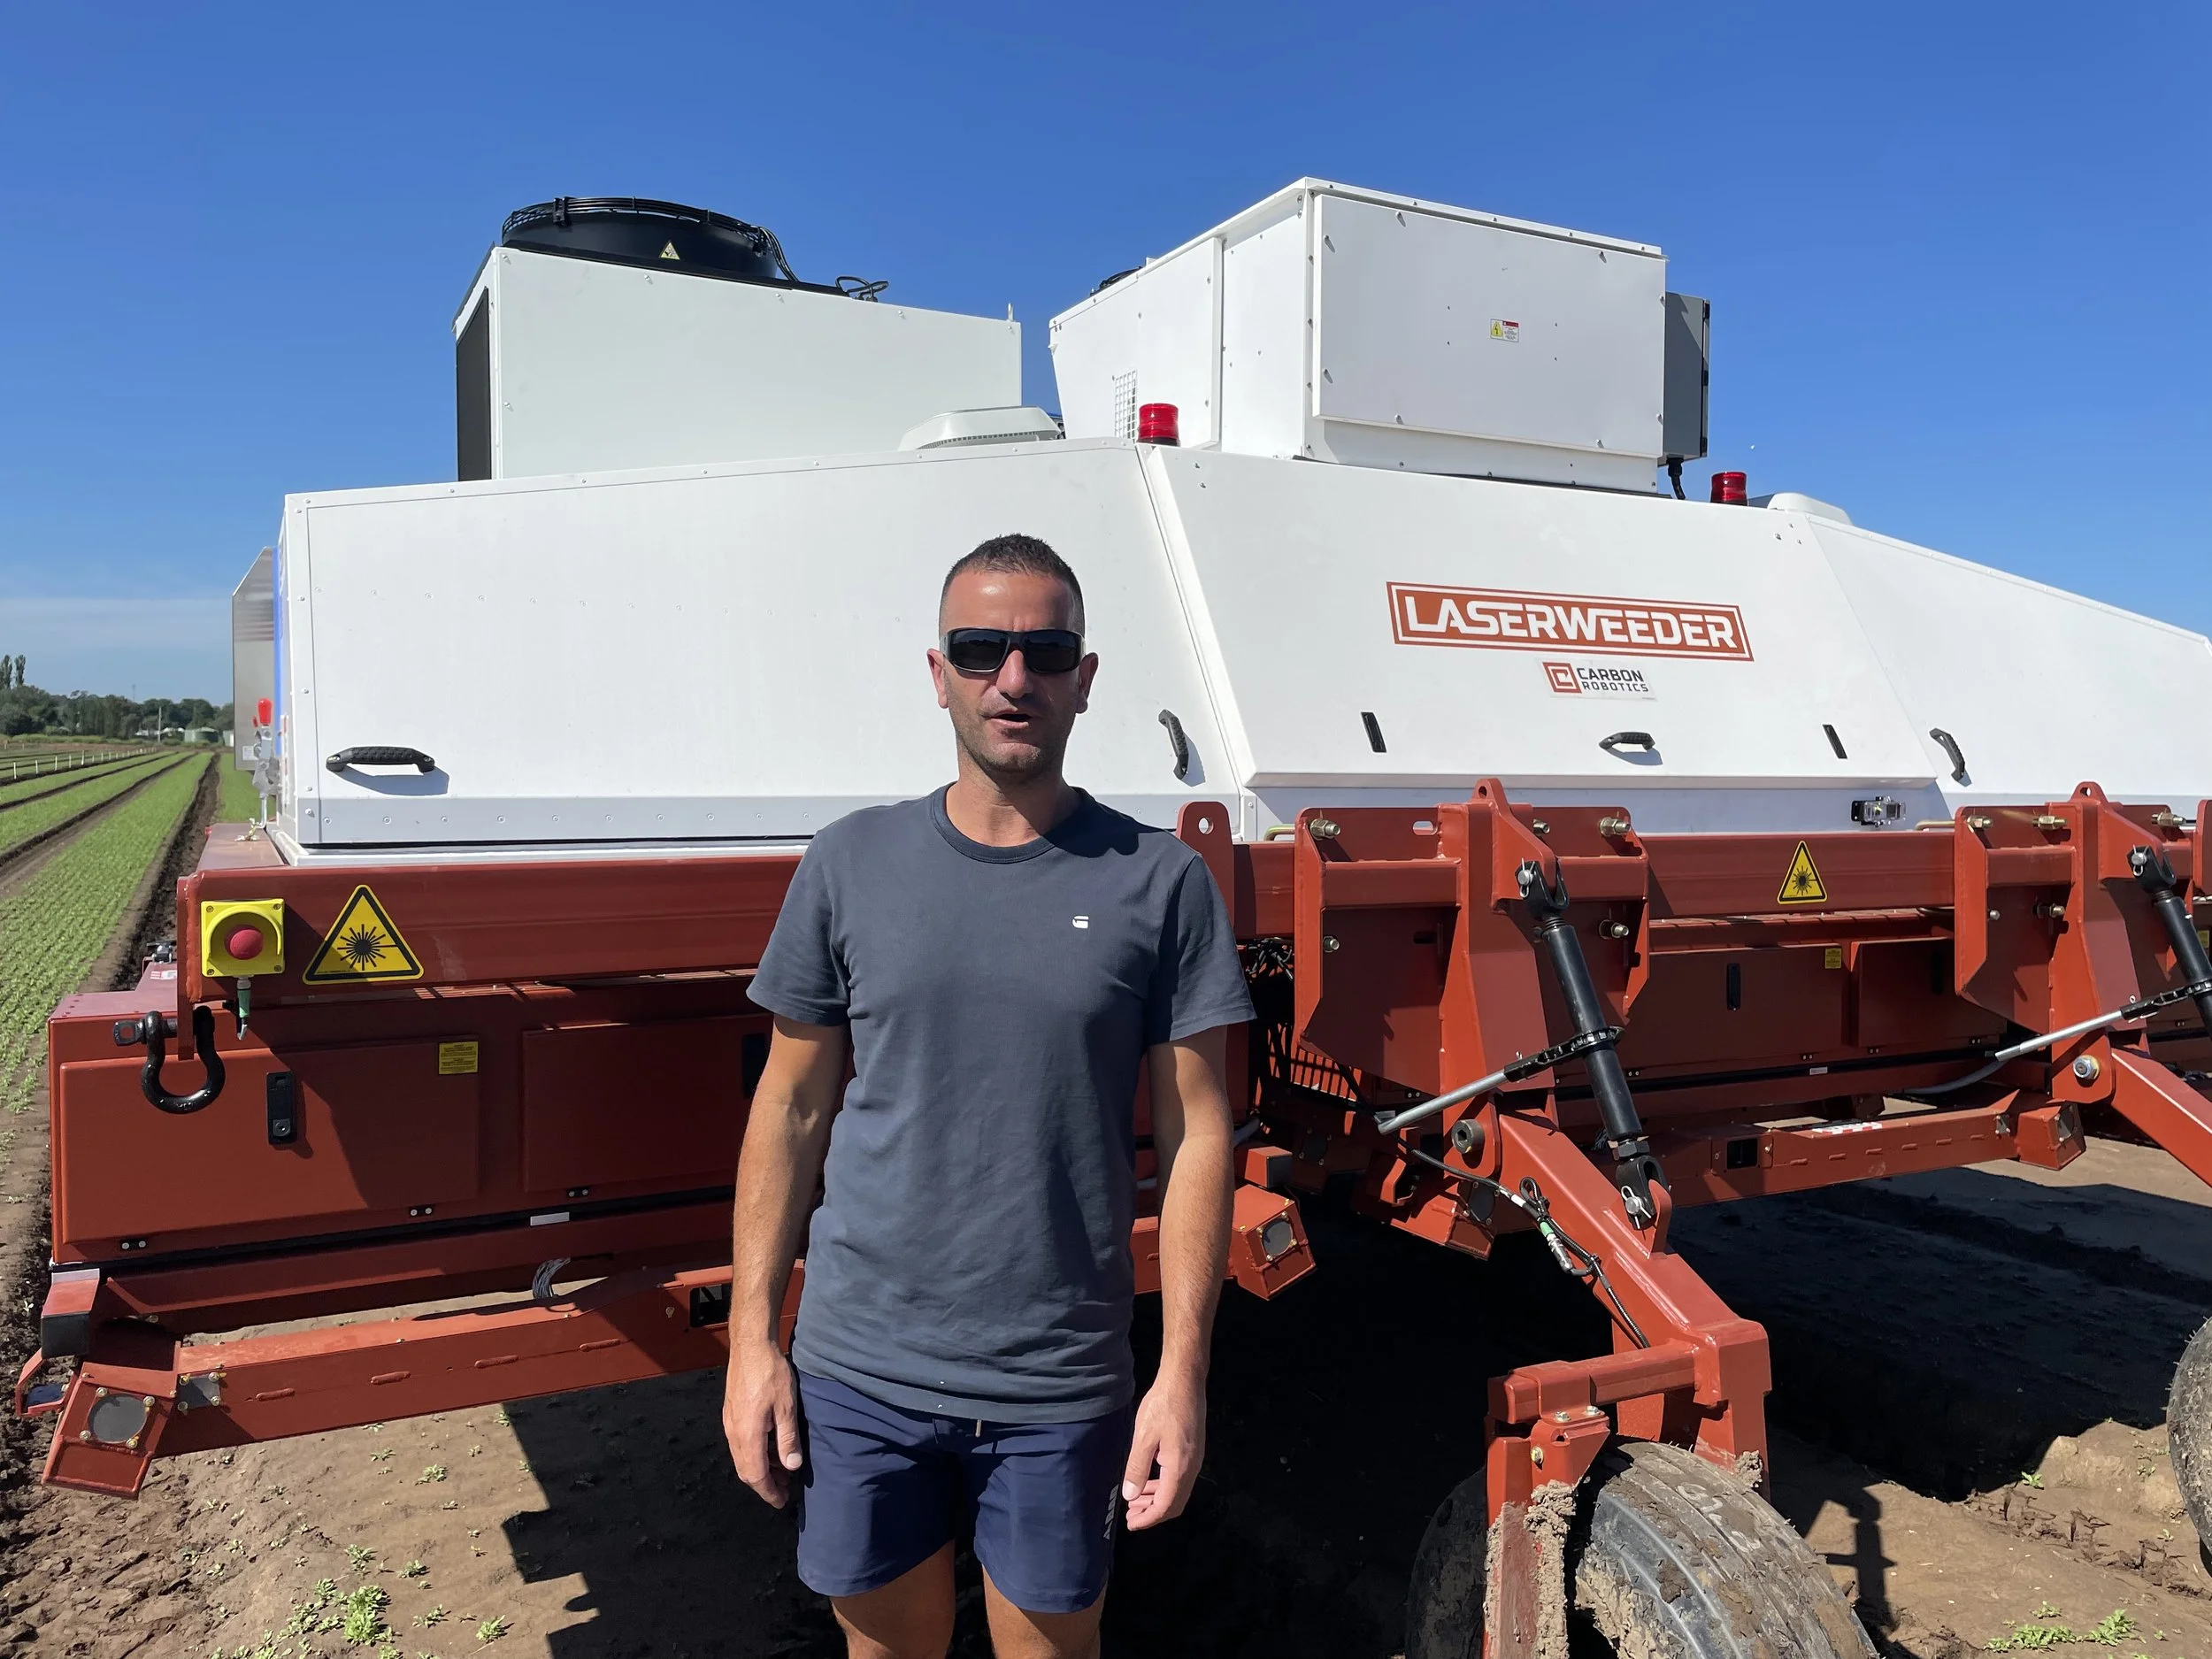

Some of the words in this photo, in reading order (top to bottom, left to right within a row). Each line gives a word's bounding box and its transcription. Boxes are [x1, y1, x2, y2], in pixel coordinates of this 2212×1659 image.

[1404, 595, 1738, 649] LASERWEEDER
[1576, 667, 1645, 682] CARBON
[1581, 680, 1649, 693] ROBOTICS
